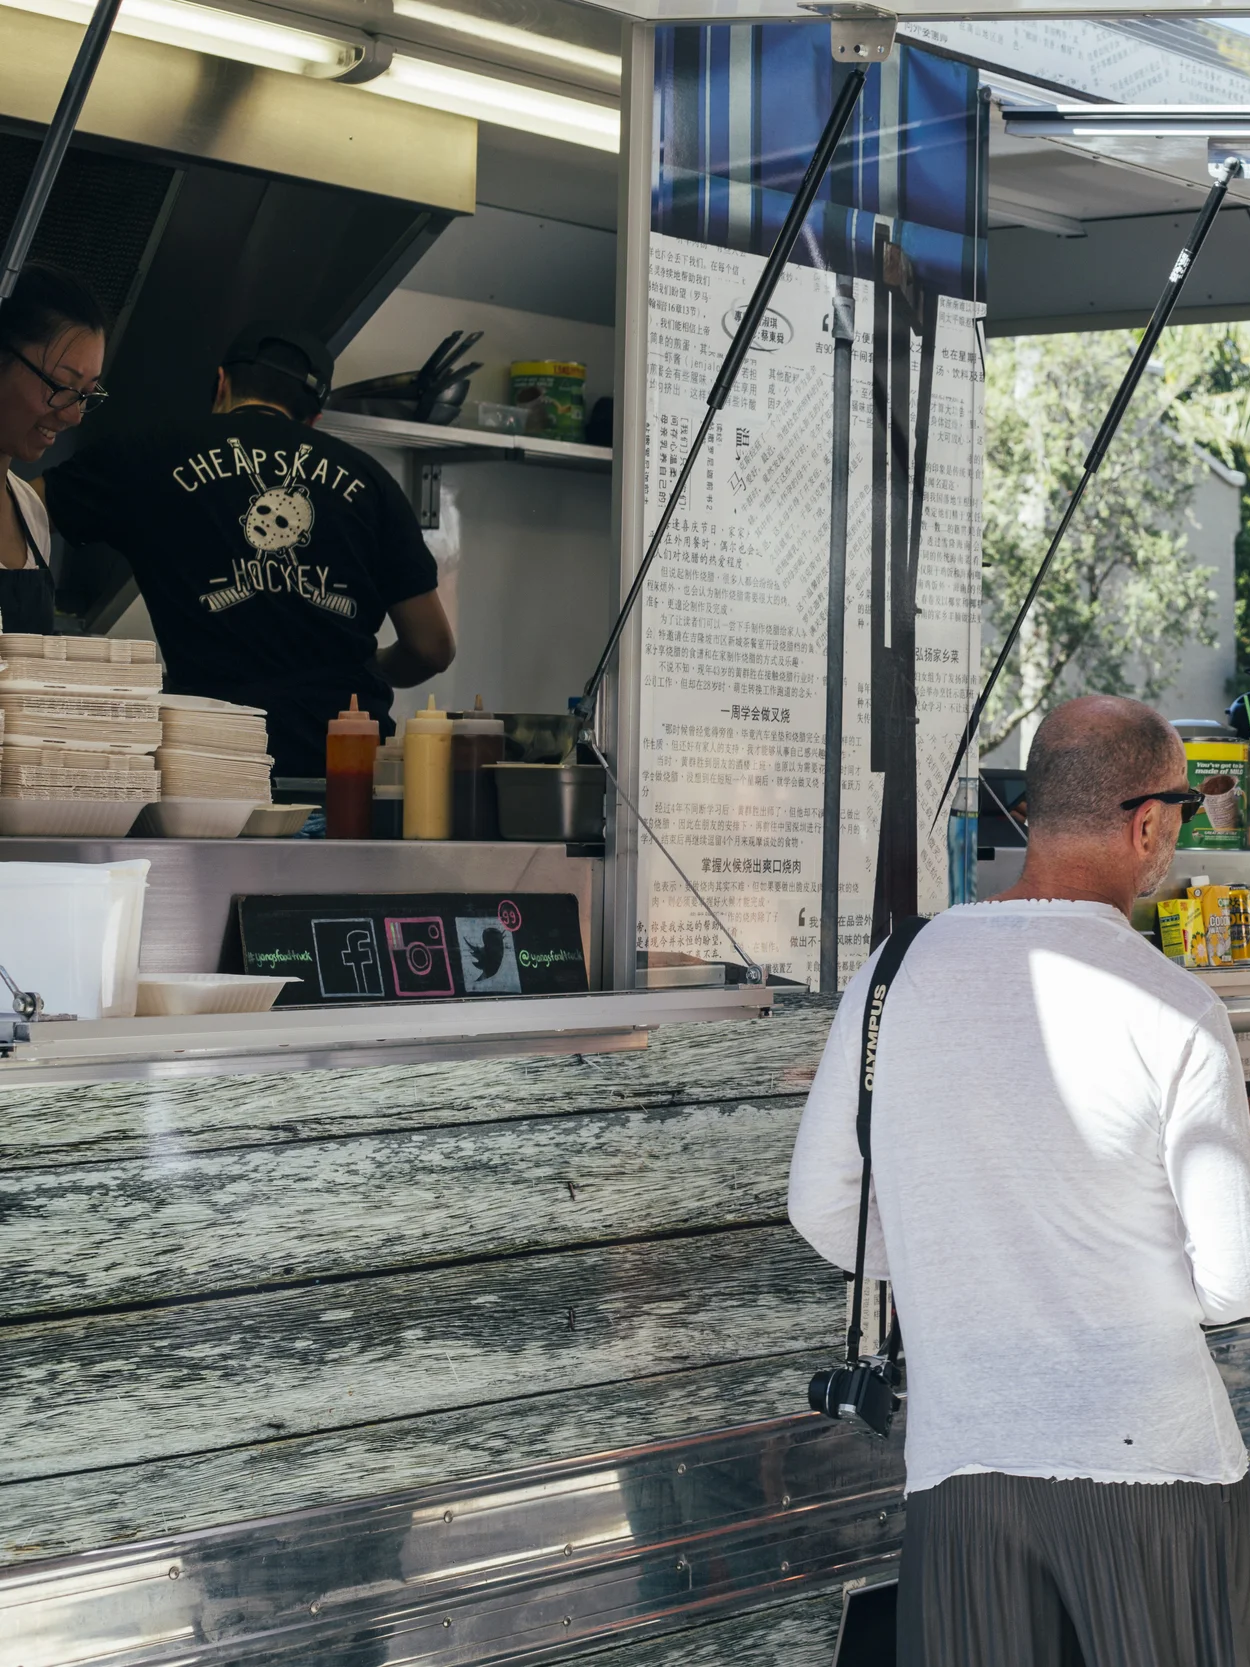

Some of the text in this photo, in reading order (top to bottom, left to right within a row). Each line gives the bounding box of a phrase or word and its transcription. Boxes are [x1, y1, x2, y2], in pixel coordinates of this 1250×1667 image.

[172, 448, 366, 503] CHEAPSKATE
[232, 558, 330, 599] HOCKEY
[915, 647, 960, 664] 弘扬家乡菜
[720, 704, 790, 724] 一周学会做叉烧
[701, 856, 802, 874] 掌握火候烧出爽口烧肉
[864, 984, 887, 1092] OLYMPUS
